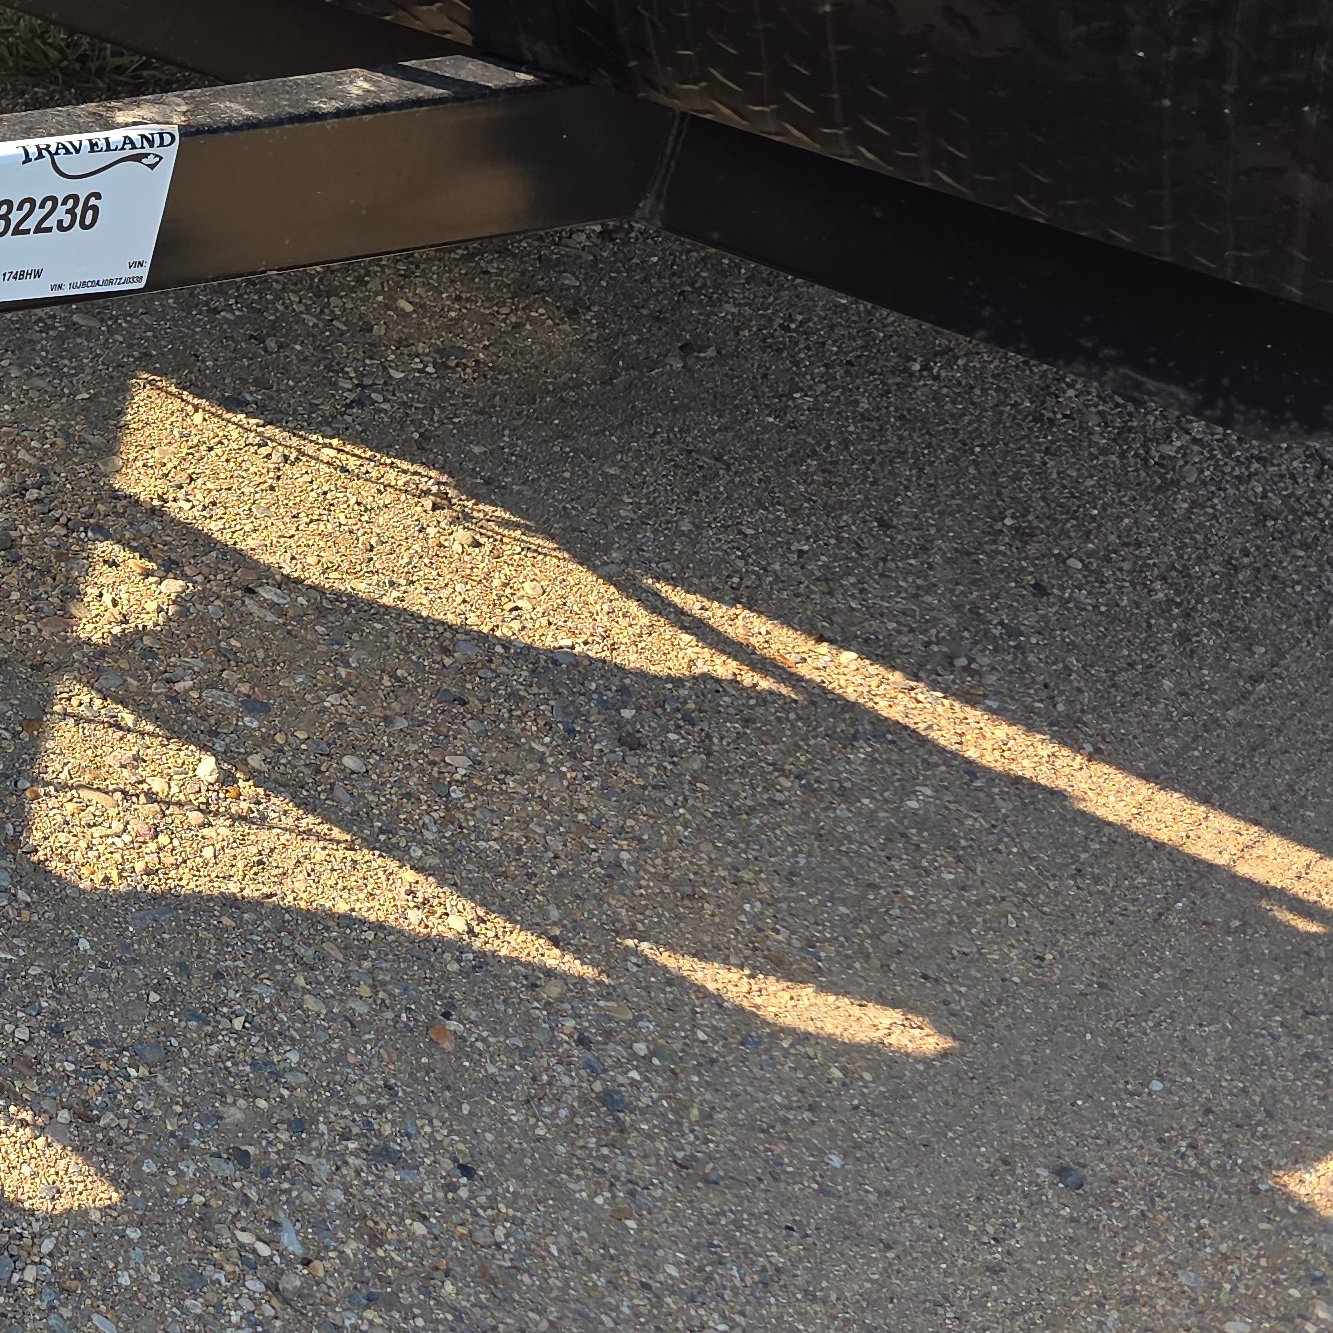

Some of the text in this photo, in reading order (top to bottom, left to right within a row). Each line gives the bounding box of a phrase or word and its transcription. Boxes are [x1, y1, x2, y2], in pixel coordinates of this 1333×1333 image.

[16, 131, 176, 165] TRAVELAND
[128, 260, 148, 269] VIN:
[2, 268, 44, 282] 174BHW
[50, 283, 66, 292] VIN:
